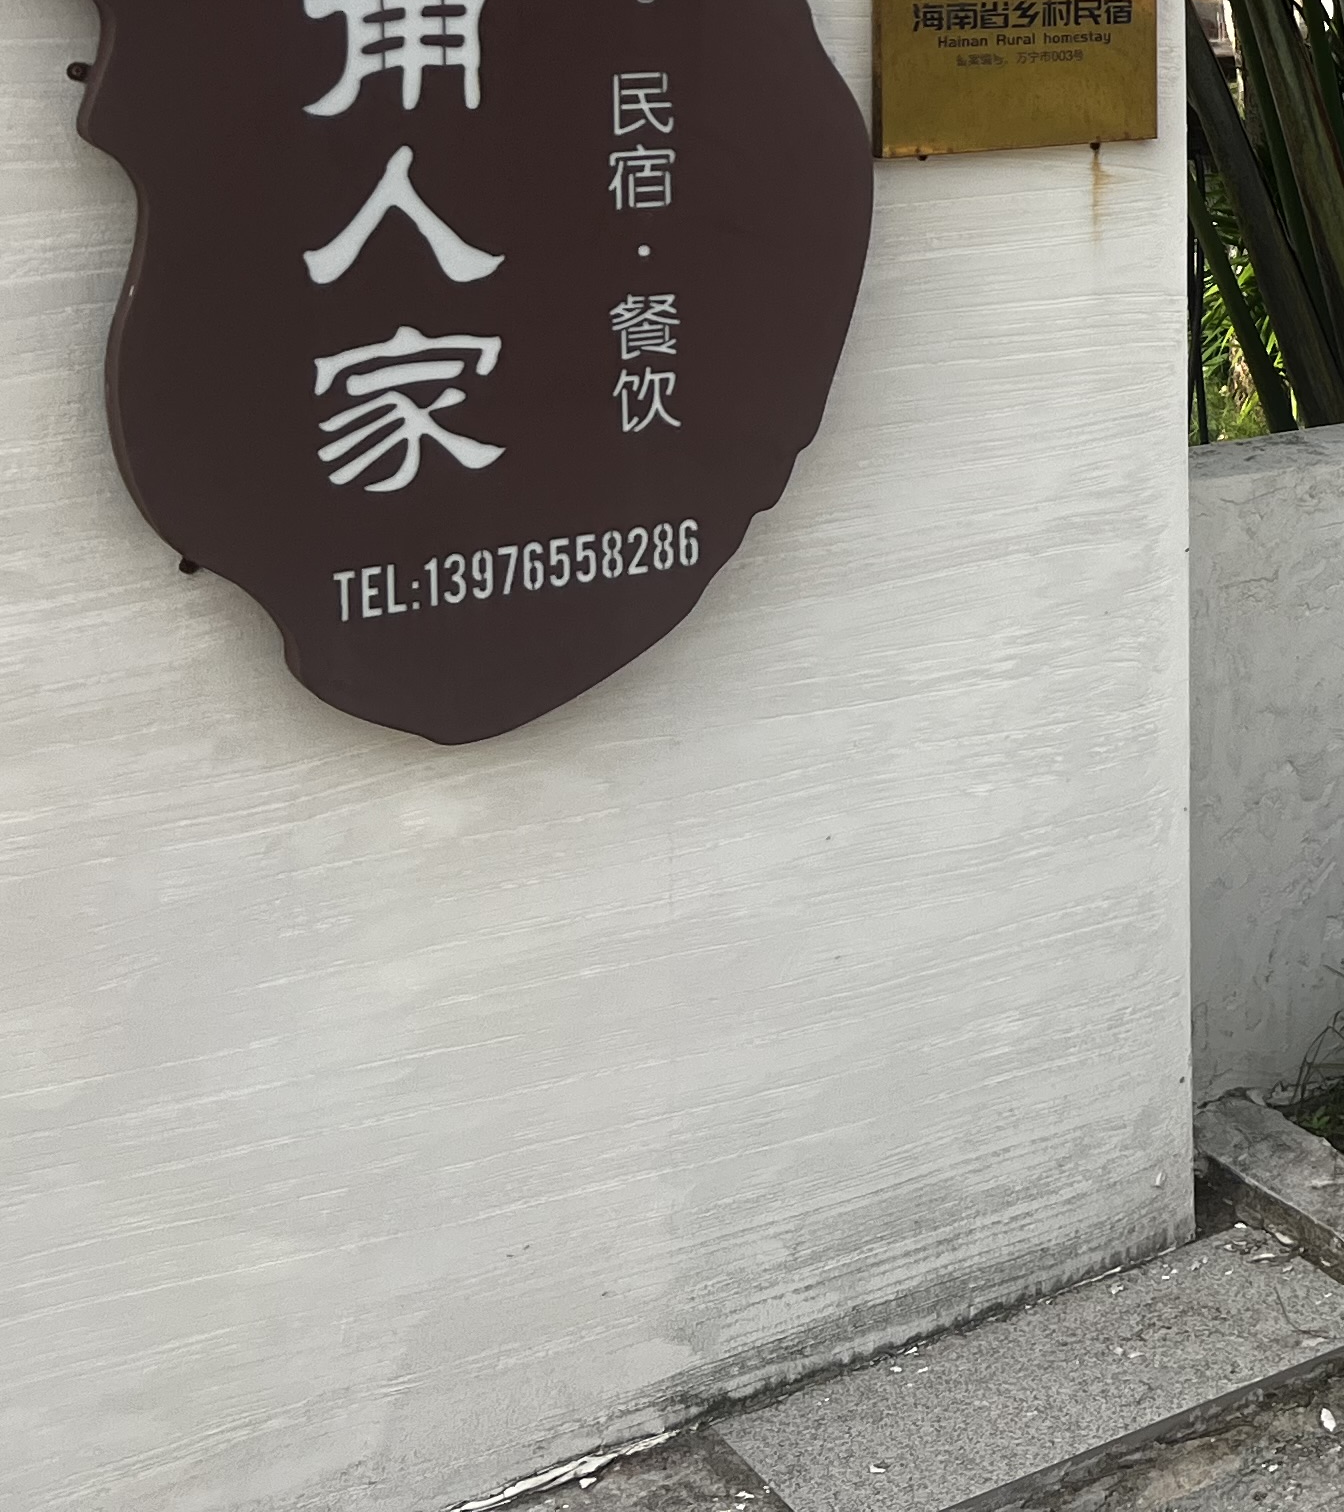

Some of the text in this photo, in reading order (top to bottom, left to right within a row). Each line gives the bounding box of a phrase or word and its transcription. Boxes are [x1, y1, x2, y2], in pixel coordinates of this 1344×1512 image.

[937, 31, 1111, 48] Hainan Rural homestay
[332, 518, 700, 622] TEL:13976558286
